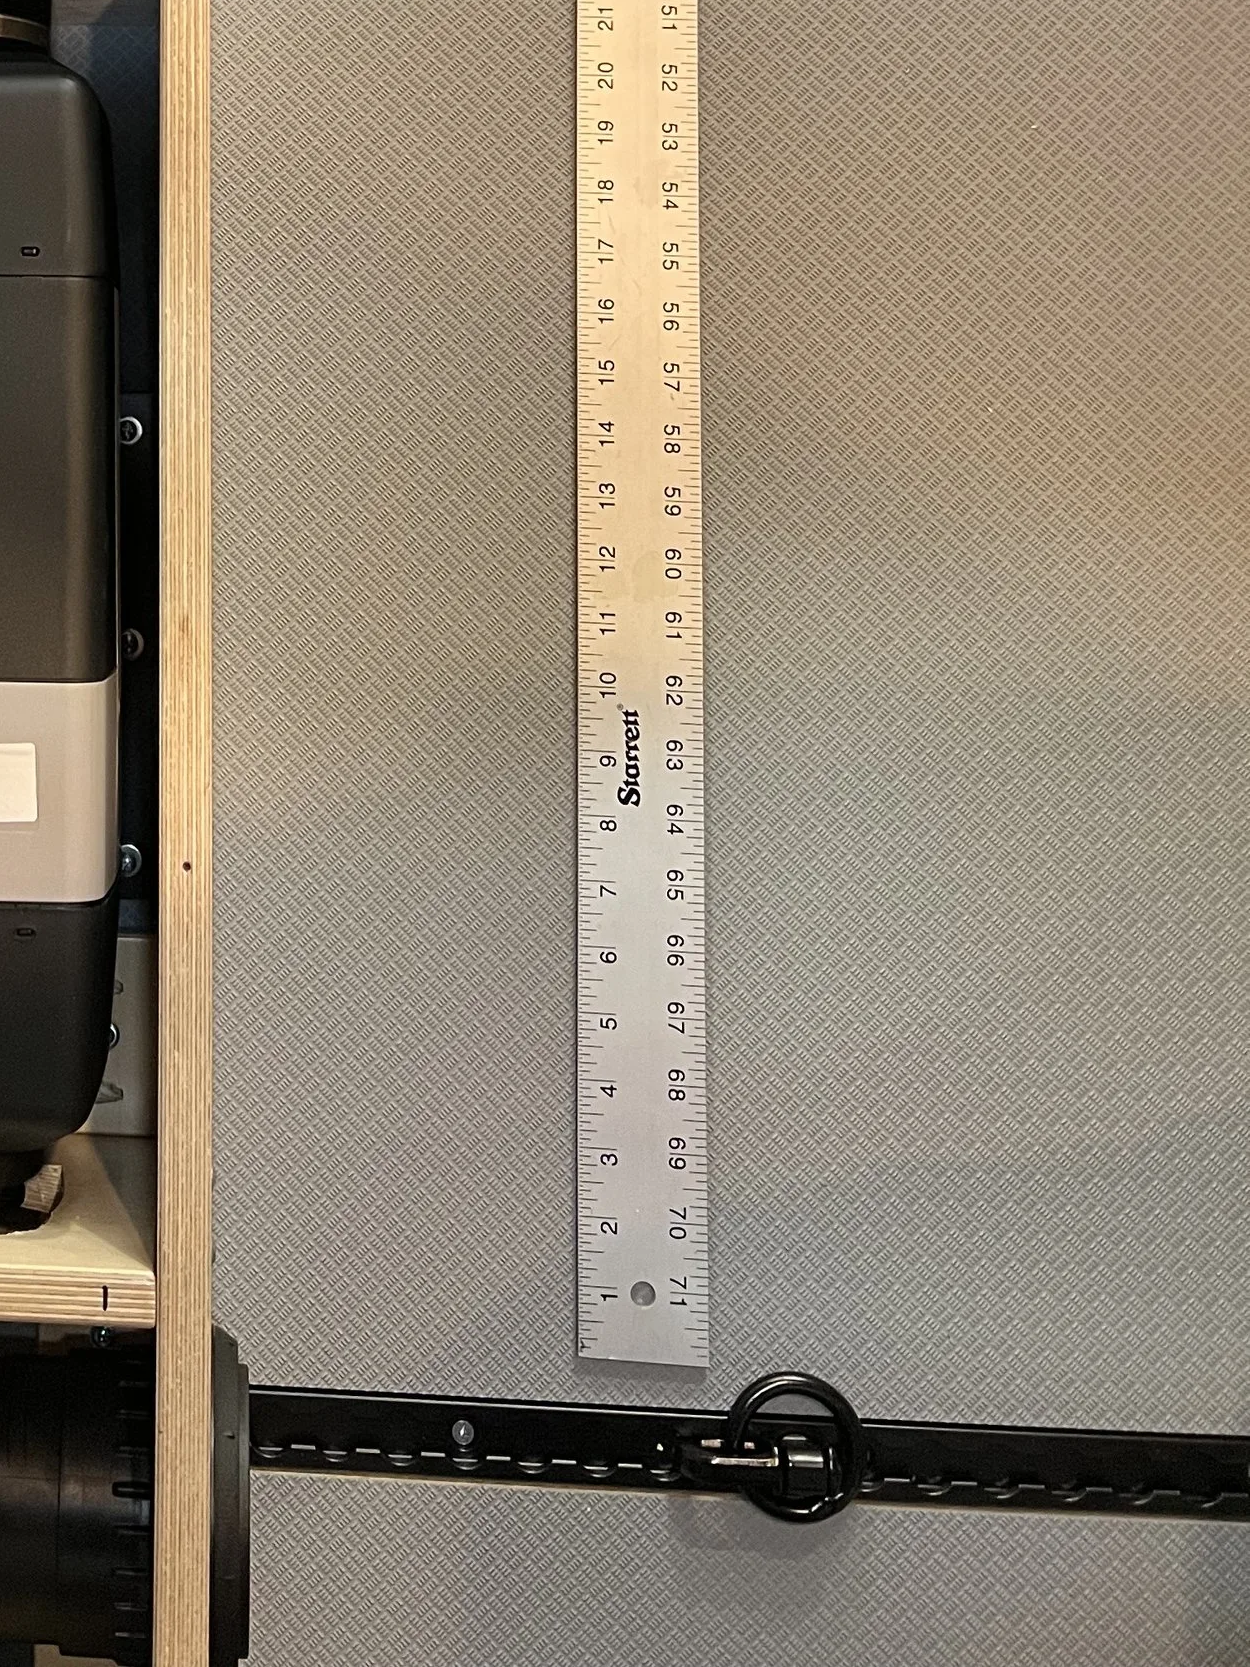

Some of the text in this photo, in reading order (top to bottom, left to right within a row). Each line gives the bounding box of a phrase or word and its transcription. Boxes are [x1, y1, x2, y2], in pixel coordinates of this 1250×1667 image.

[597, 7, 614, 32] 21
[661, 4, 678, 34] 51
[597, 61, 614, 90] 20
[661, 63, 679, 92] 52
[597, 120, 615, 145] 19
[661, 122, 679, 151] 53
[597, 179, 615, 205] 18
[661, 181, 679, 211] 54
[597, 238, 614, 265] 17
[662, 241, 680, 271] 55
[597, 298, 615, 325] 16
[662, 301, 680, 331] 56
[597, 359, 615, 386] 15
[662, 361, 681, 393] 57
[597, 420, 615, 448] 14
[663, 423, 682, 454] 58
[598, 482, 616, 510] 13
[663, 485, 682, 517] 59
[598, 545, 616, 573] 12
[664, 548, 682, 580] 60
[598, 612, 617, 636] 11
[664, 611, 683, 639] 61
[598, 671, 617, 699] 10
[665, 675, 684, 707] 62
[598, 754, 617, 768] 9
[616, 709, 641, 808] Starrett
[665, 739, 684, 771] 63
[599, 819, 618, 832] 8
[666, 804, 685, 836] 64
[599, 884, 617, 898] 7
[666, 869, 685, 901] 65
[599, 951, 618, 965] 6
[666, 934, 685, 967] 66
[599, 1017, 618, 1031] 5
[667, 1001, 686, 1035] 67
[599, 1084, 618, 1099] 4
[667, 1068, 687, 1102] 68
[599, 1153, 619, 1167] 3
[668, 1136, 687, 1171] 69
[599, 1220, 618, 1236] 2
[668, 1206, 688, 1240] 70
[599, 1293, 619, 1302] 1
[669, 1275, 688, 1307] 71
